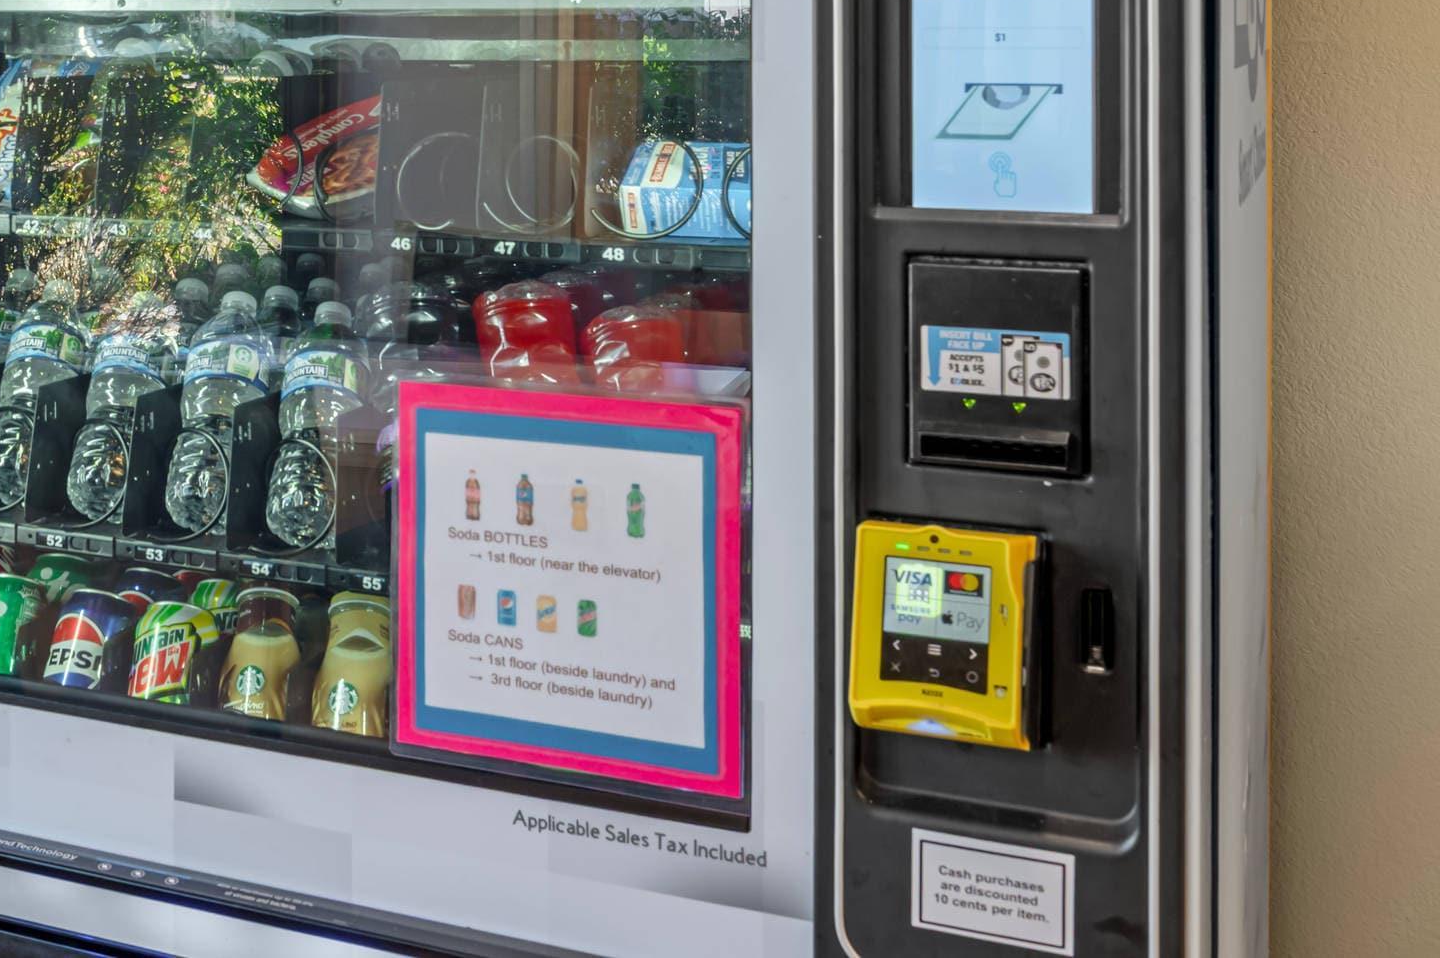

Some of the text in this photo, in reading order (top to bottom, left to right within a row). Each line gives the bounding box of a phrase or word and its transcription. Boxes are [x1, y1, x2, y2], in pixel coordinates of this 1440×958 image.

[391, 238, 411, 251] 46
[494, 241, 516, 255] 47
[602, 247, 625, 261] 48
[103, 347, 148, 362] MOUNTAIN
[46, 536, 63, 548] 52
[448, 526, 549, 549] Soda BOTTLES
[146, 548, 164, 562] 53
[251, 563, 271, 576] 54
[488, 551, 662, 584] 1st floor (near the elevator)
[892, 569, 932, 586] VISA
[362, 576, 382, 591] 55
[957, 612, 985, 632] Pay
[448, 629, 524, 651] Soda CANS
[488, 654, 676, 691] 1st floor (beside laundry) and
[491, 673, 653, 710] 3rd floor (beside laundry)
[512, 809, 768, 868] Applicable Sales Tax Included
[938, 865, 1045, 893] Cash purchases
[940, 881, 1039, 907] are discounted
[934, 893, 1050, 924] 10 cents per item.
